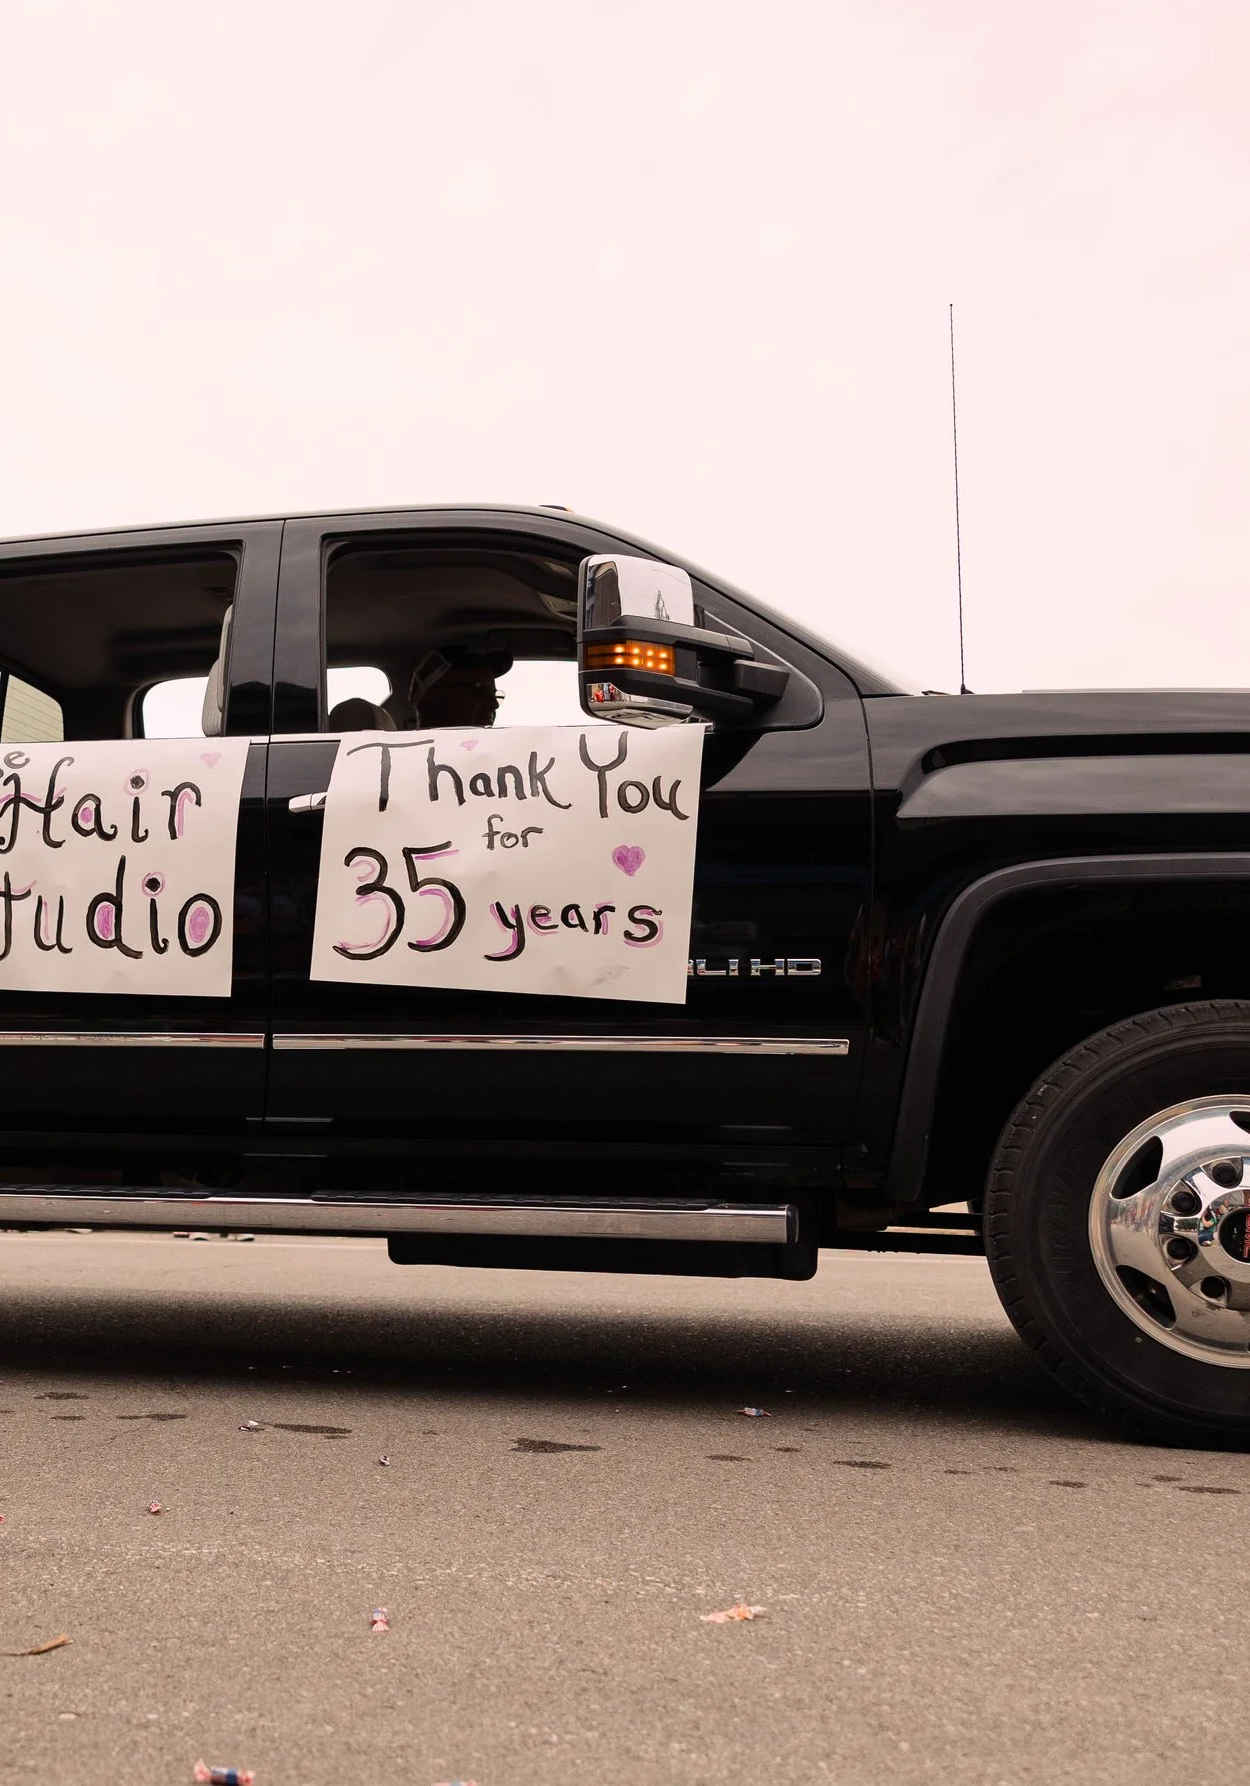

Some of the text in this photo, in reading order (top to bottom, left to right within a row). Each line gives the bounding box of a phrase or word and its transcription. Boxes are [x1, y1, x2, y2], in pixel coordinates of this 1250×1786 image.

[346, 731, 690, 821] Thank You
[481, 813, 544, 851] for
[332, 840, 467, 961] 35
[483, 900, 663, 962] years
[687, 958, 822, 976] LI HD
